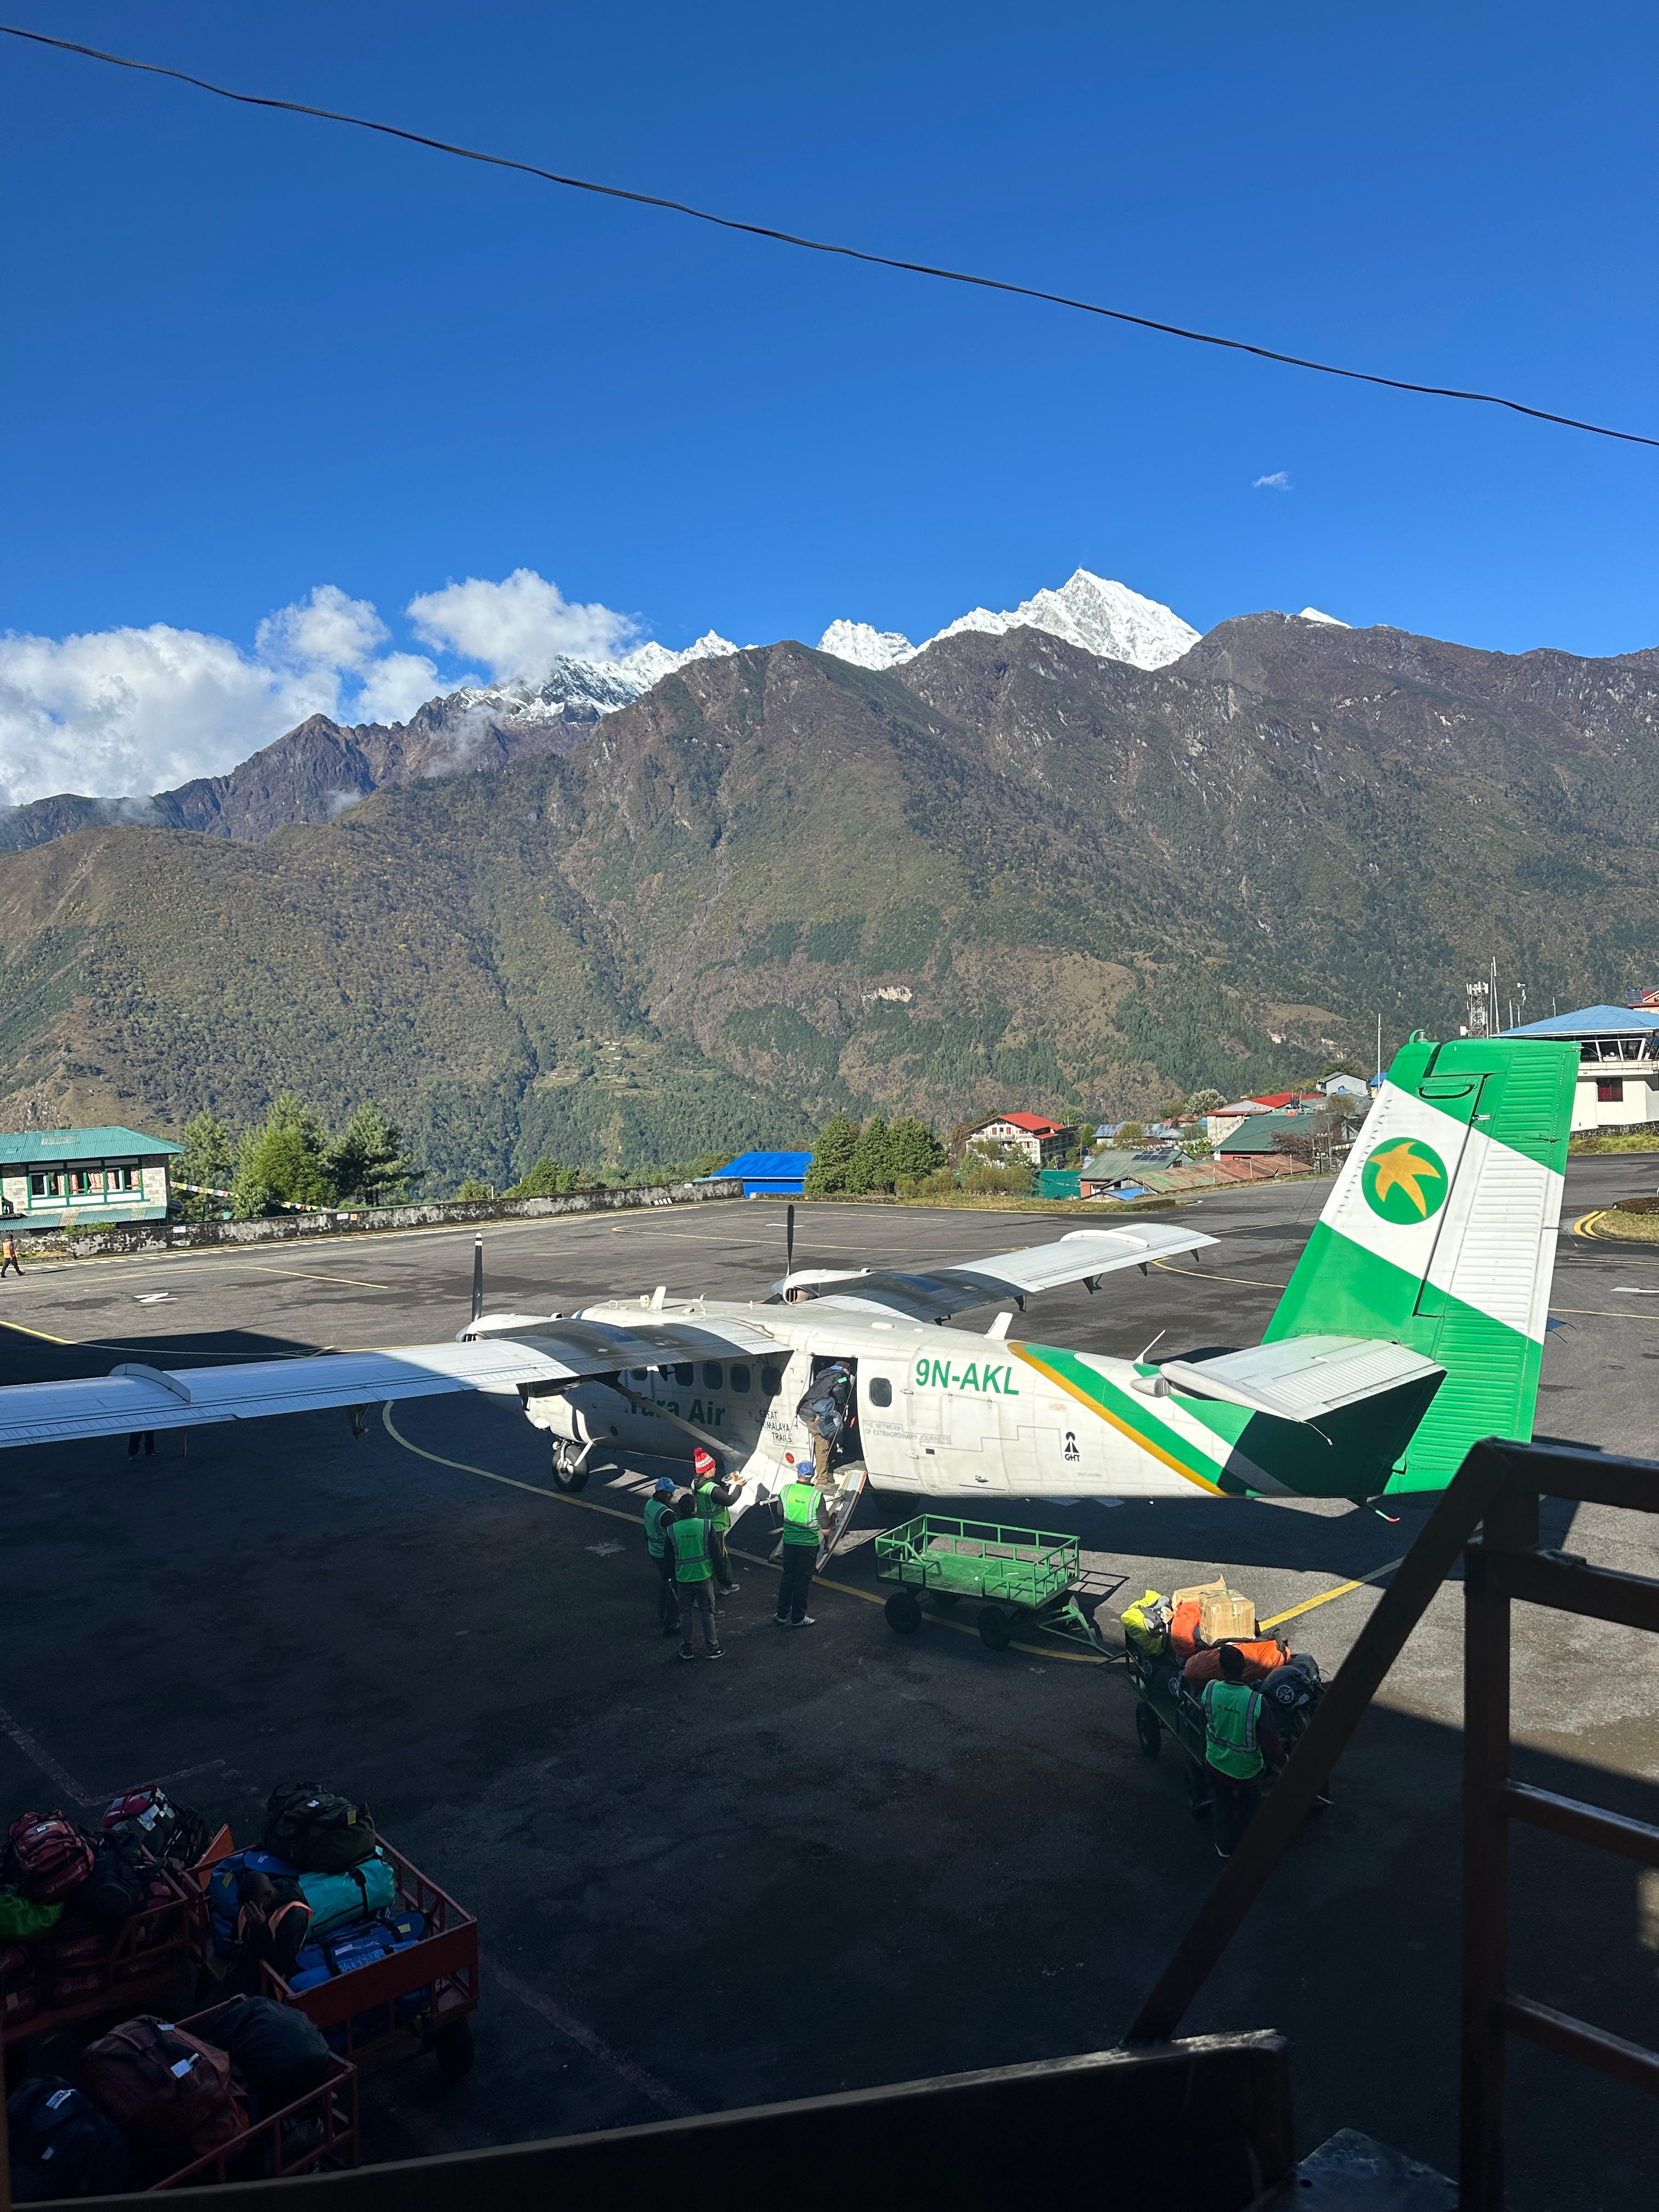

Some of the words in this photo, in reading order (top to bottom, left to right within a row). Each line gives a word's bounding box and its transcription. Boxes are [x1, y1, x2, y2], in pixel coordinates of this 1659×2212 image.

[915, 1358, 1019, 1395] 9N-AKL
[688, 1399, 726, 1426] Air
[759, 1409, 777, 1420] GREAT
[875, 1423, 901, 1431] NETWORK
[771, 1432, 792, 1443] TRAILS
[873, 1429, 917, 1440] EXTRAORDINARY
[919, 1435, 950, 1443] JOURNEYS
[55, 1865, 82, 1887] Intrepid
